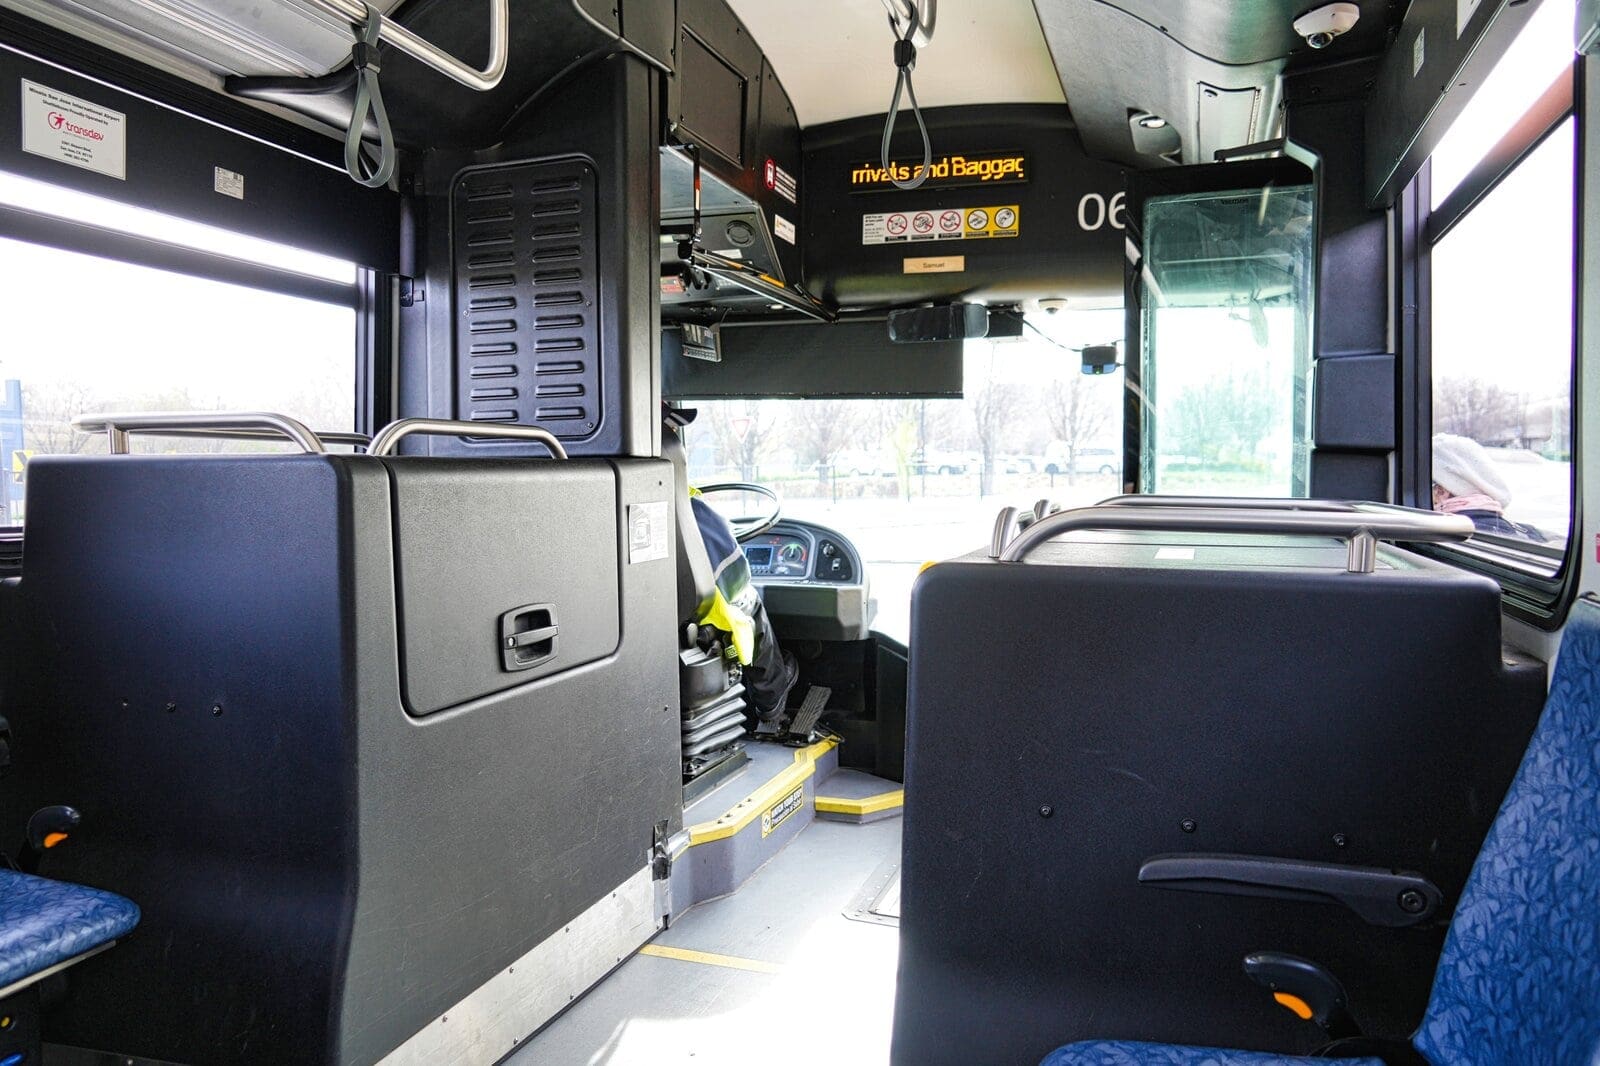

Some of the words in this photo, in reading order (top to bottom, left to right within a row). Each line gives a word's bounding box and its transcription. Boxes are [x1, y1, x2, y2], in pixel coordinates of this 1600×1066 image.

[72, 102, 102, 116] International
[104, 113, 120, 123] Airport
[66, 121, 104, 141] transdev
[913, 157, 949, 178] and
[1078, 191, 1126, 231] 06
